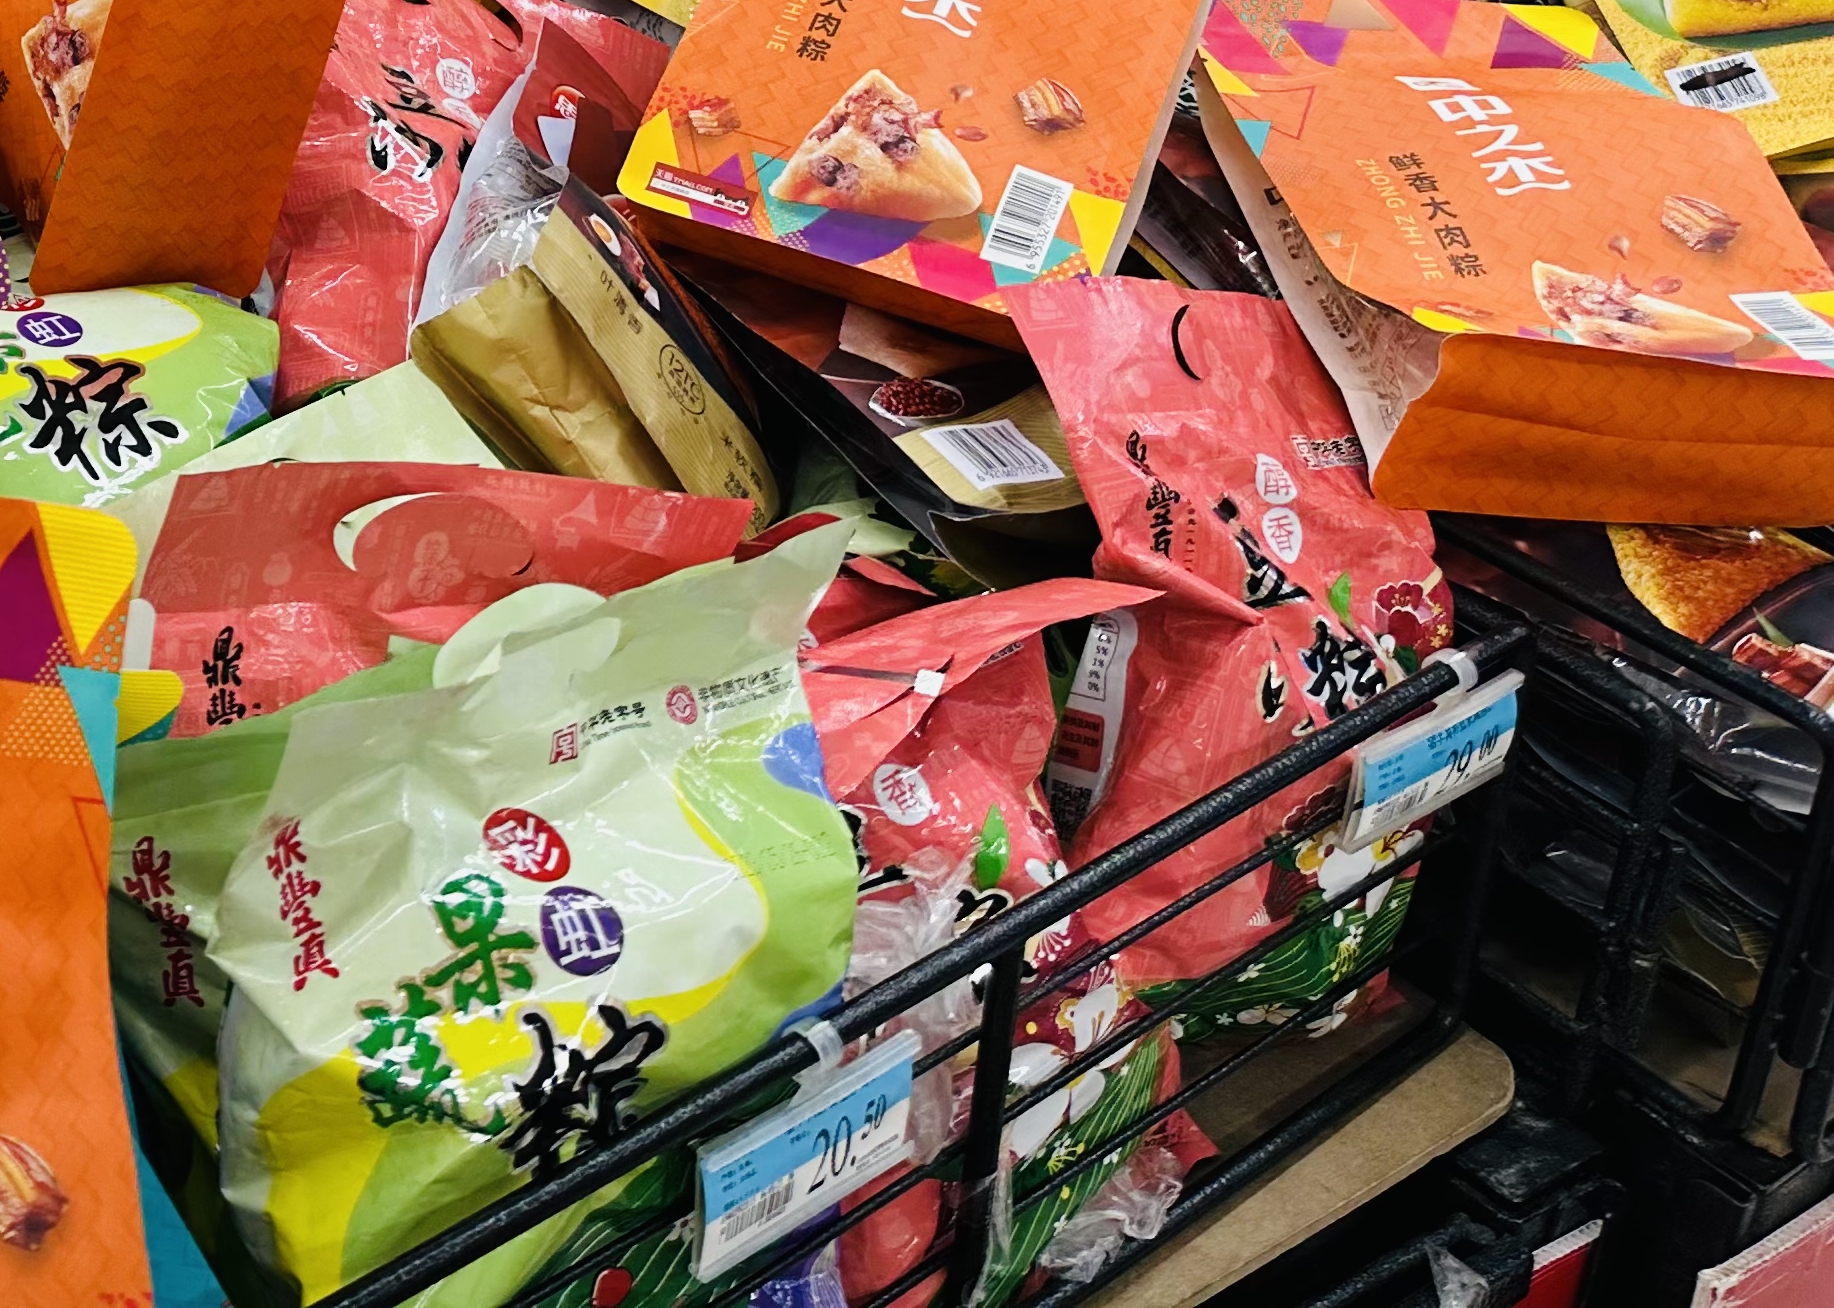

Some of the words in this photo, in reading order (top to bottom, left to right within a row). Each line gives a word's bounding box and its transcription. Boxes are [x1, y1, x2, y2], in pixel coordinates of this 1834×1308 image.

[766, 24, 794, 53] JIE
[1427, 93, 1571, 198] 中之杰
[1355, 158, 1405, 210] ZHONG
[1392, 213, 1424, 246] ZHI
[1413, 248, 1445, 283] JIE
[1387, 152, 1488, 282] 鲜香大肉粽
[25, 312, 79, 347] 虹
[547, 900, 622, 970] 虹
[807, 1093, 888, 1196] 20.50
